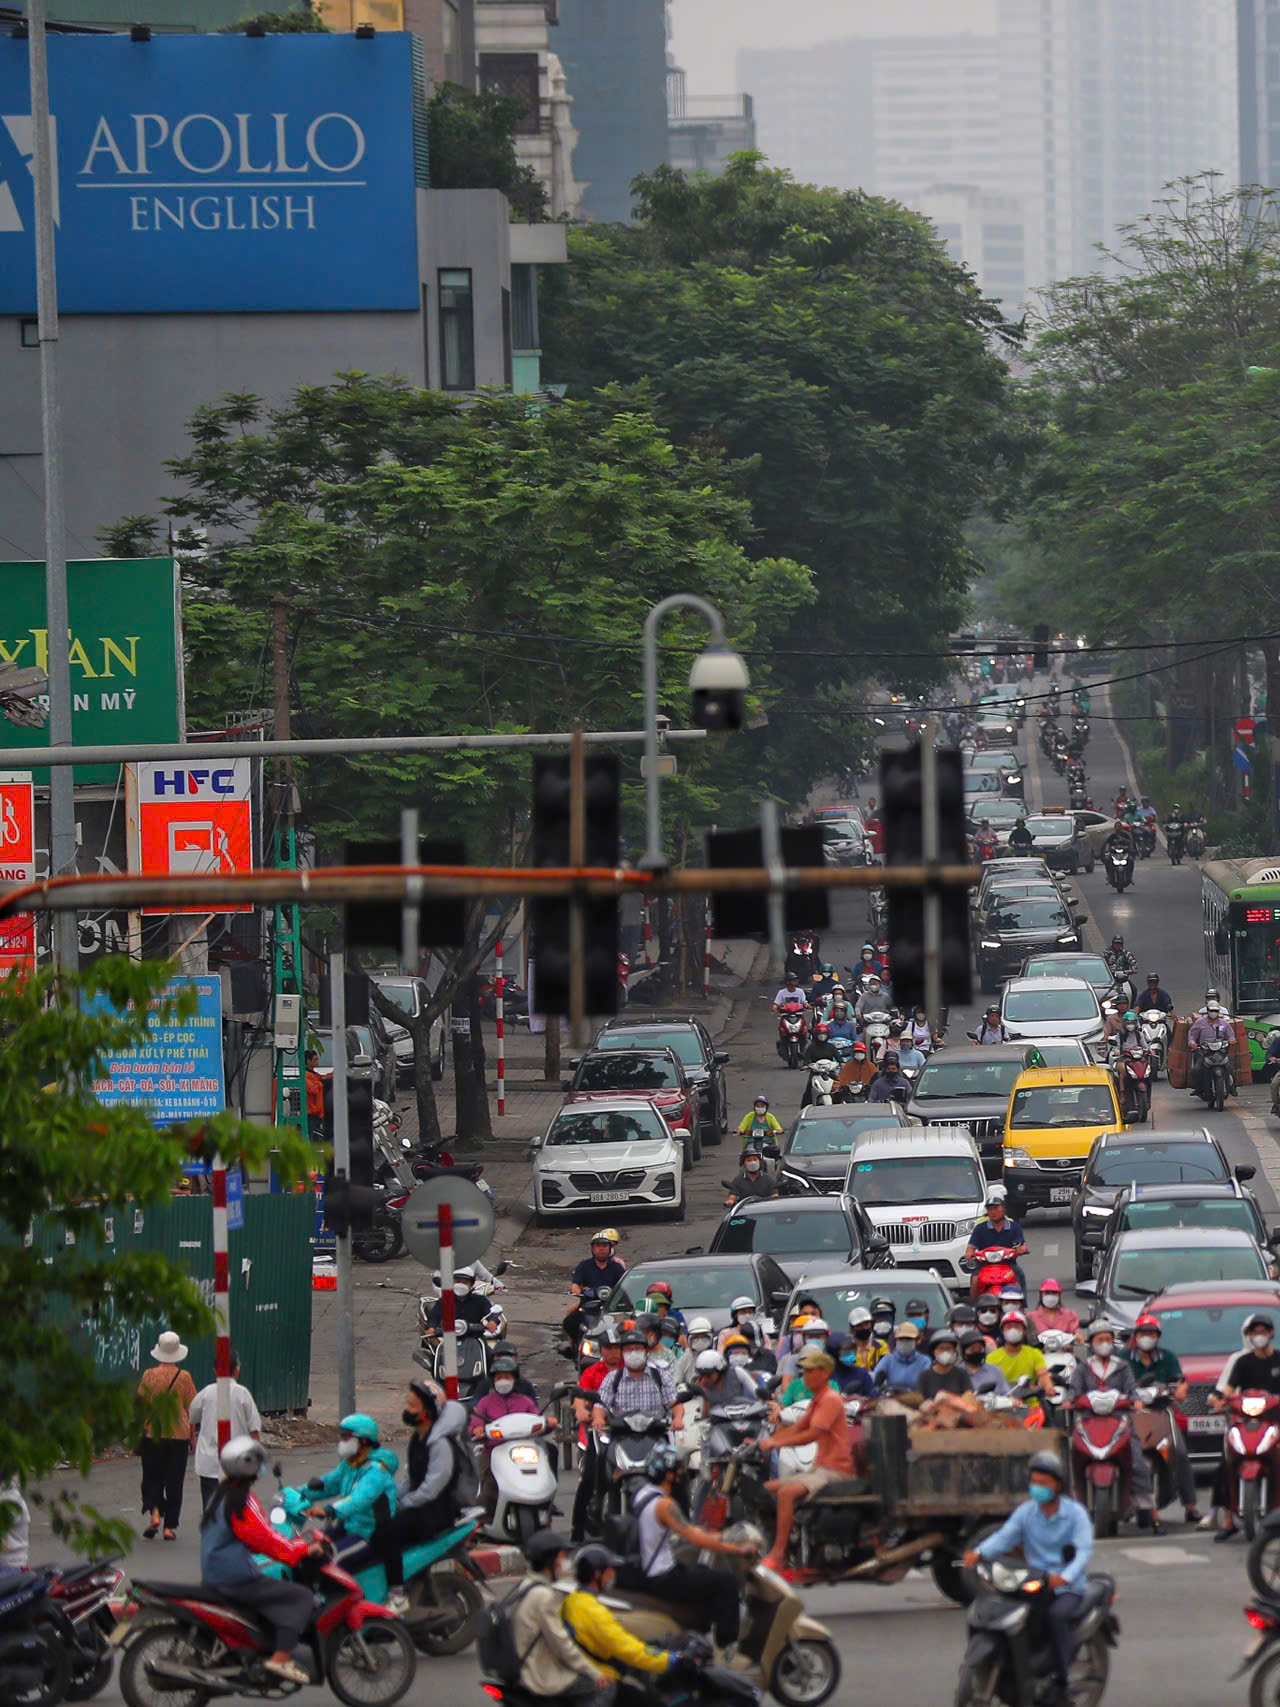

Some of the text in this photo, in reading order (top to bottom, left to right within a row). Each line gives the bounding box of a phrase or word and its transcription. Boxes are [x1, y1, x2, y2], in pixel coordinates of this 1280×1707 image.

[78, 112, 367, 175] APOLLO
[131, 195, 317, 232] ENGLISH
[154, 769, 235, 795] HFC
